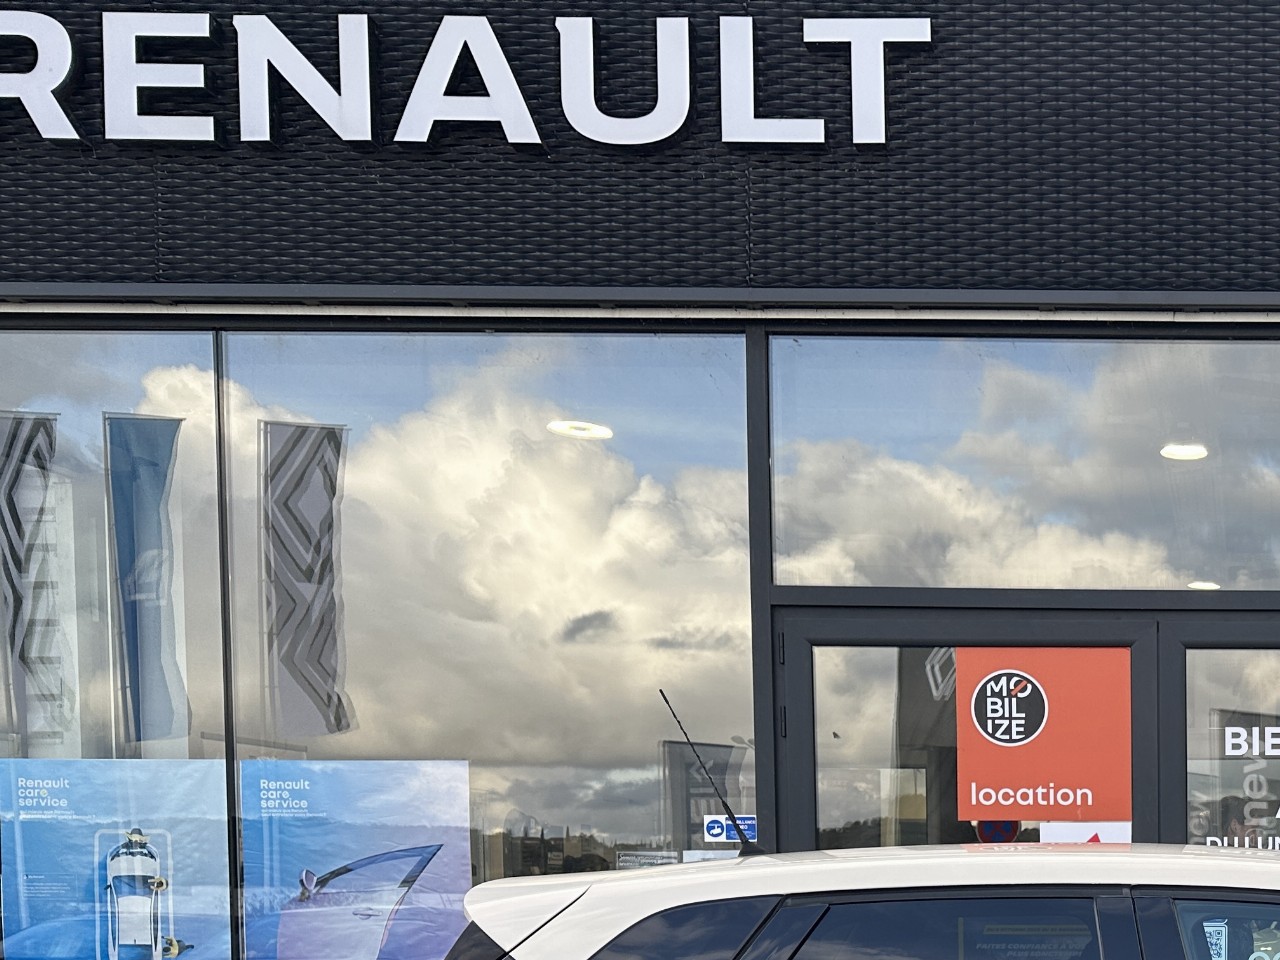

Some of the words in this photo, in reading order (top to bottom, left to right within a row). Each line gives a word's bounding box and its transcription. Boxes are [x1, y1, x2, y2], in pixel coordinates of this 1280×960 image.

[0, 10, 932, 145] RENAULT
[986, 697, 1026, 718] BIL
[987, 719, 1026, 740] IZE
[18, 778, 70, 789] Renault
[260, 779, 310, 790] Renault
[18, 789, 48, 798] care
[260, 790, 290, 799] care
[971, 782, 1093, 806] location
[18, 797, 68, 807] service
[260, 798, 308, 808] service
